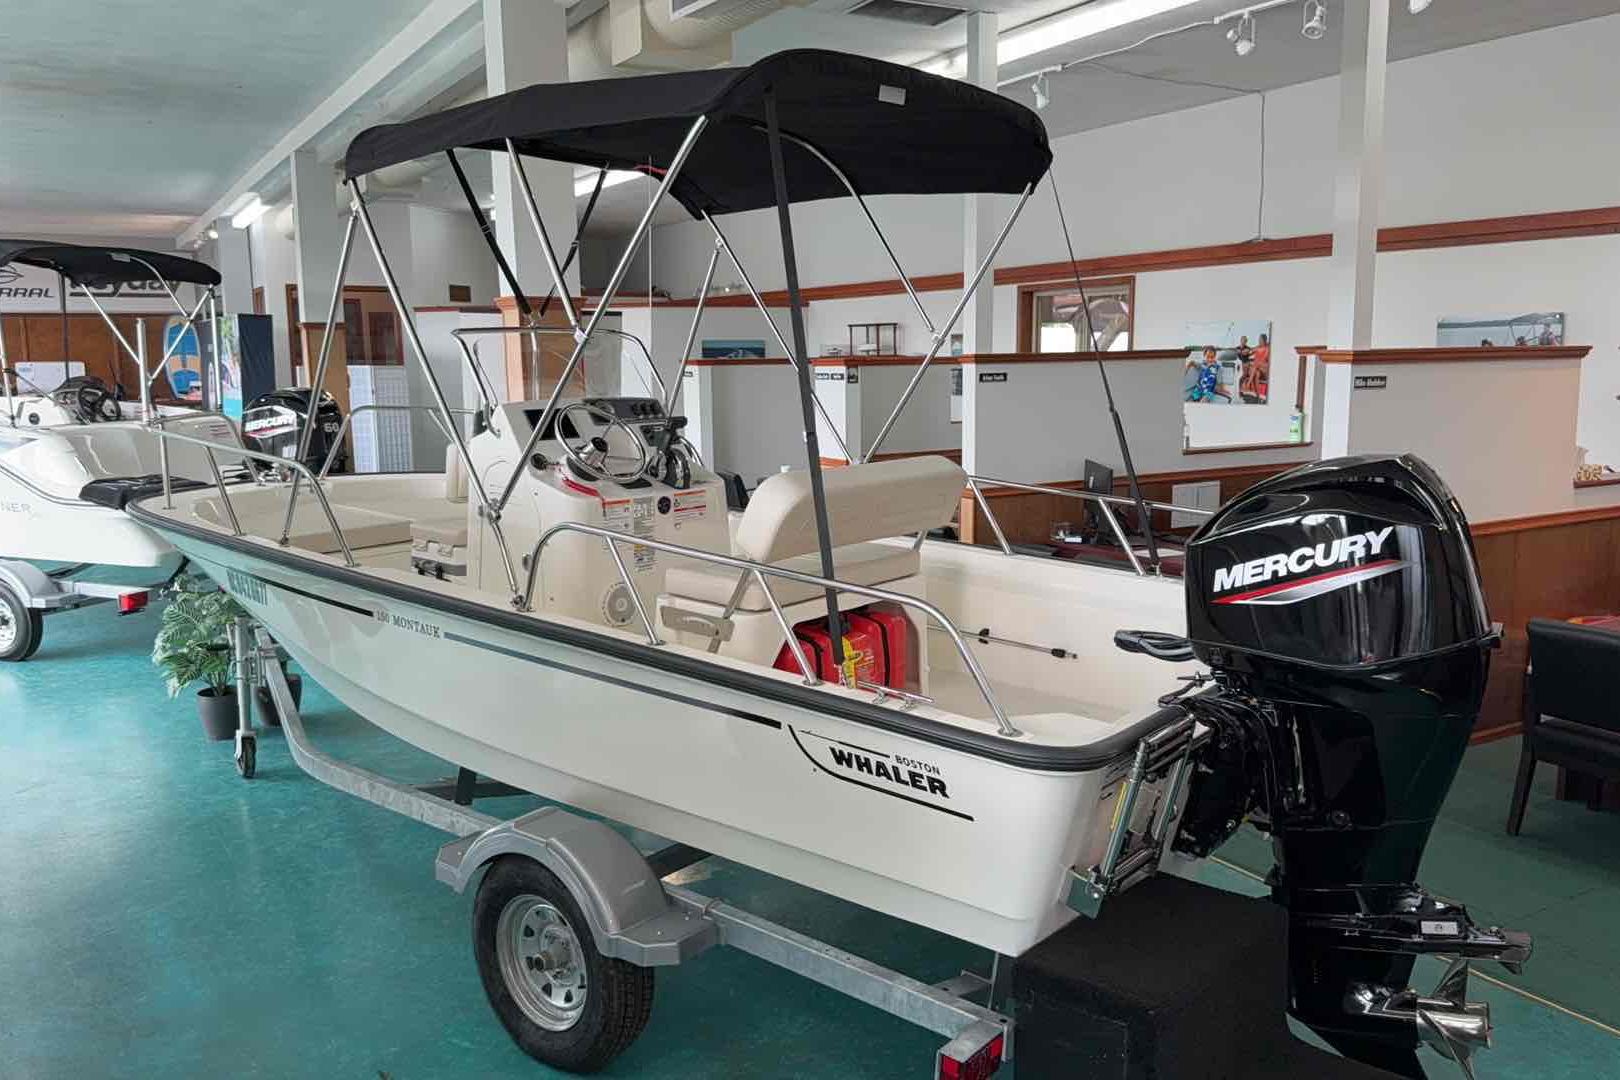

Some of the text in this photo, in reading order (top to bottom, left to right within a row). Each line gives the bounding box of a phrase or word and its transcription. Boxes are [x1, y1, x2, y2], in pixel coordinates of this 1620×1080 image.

[1213, 525, 1395, 592] MERCURY
[392, 614, 441, 639] MONTAUK
[829, 745, 950, 799] WHALER
[894, 754, 941, 776] BOSTON
